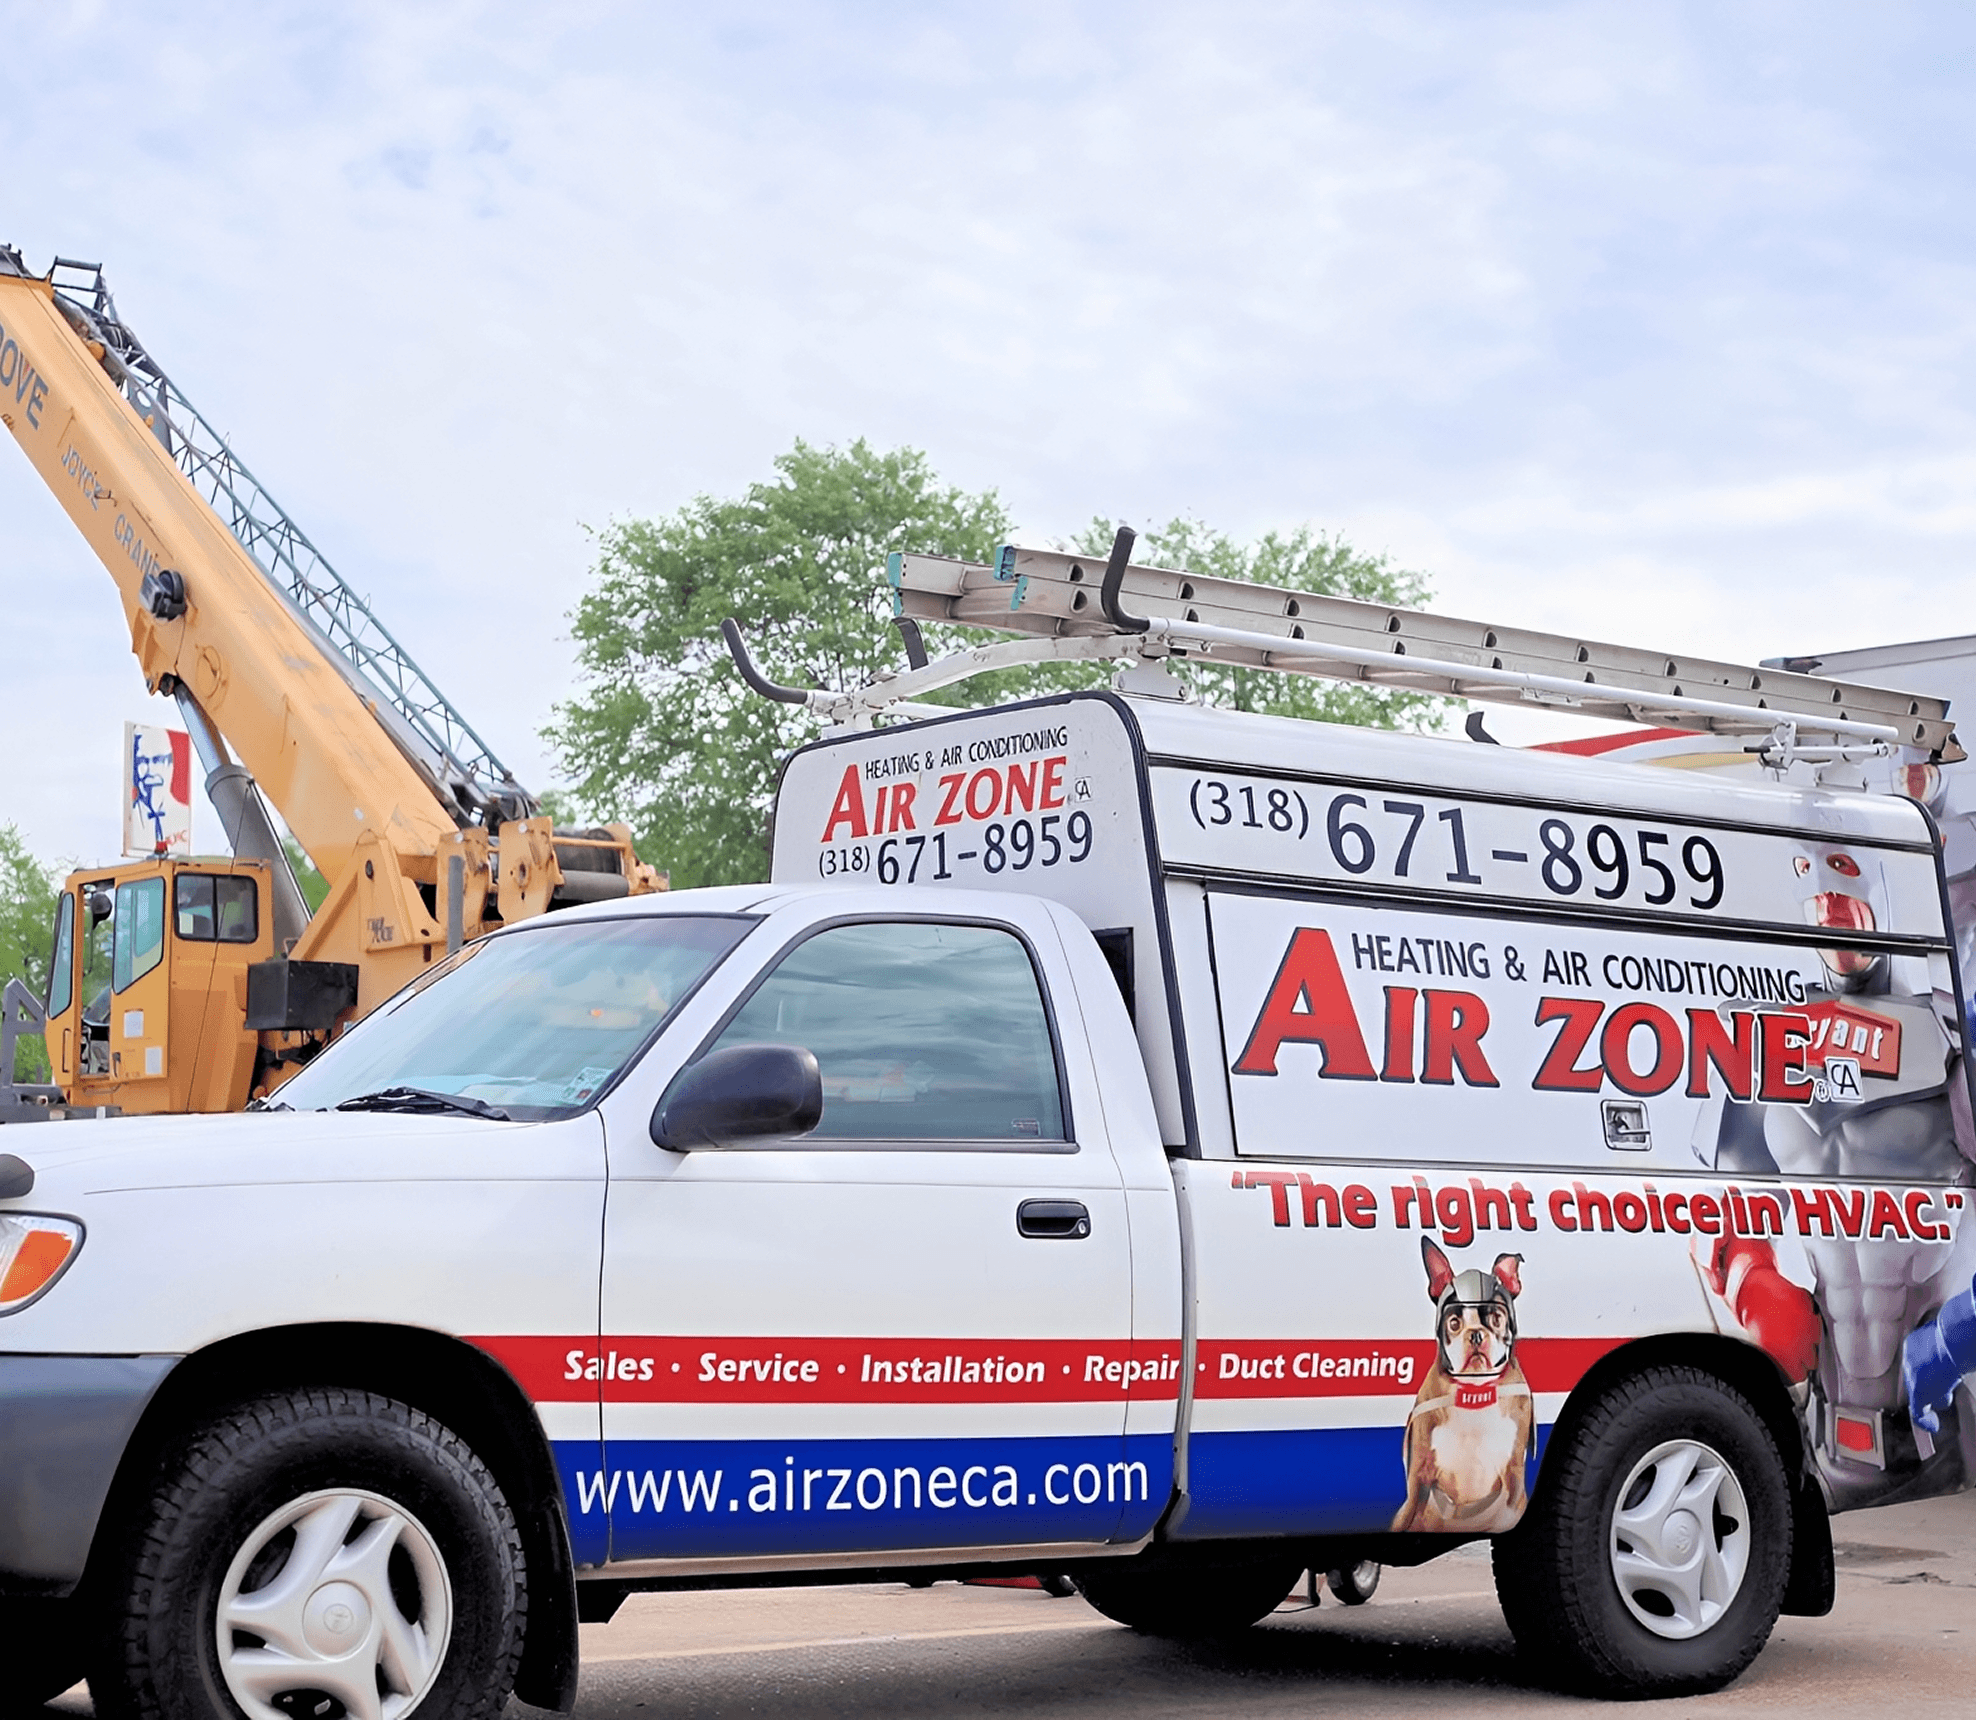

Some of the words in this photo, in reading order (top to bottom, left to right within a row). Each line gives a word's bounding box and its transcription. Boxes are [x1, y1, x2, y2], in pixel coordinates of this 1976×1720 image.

[0, 323, 48, 431] OVE
[866, 753, 919, 780] HEATING
[925, 751, 934, 770] &
[941, 746, 962, 767] AIR
[969, 726, 1067, 762] CONDITIONING
[821, 764, 917, 843] AIR
[933, 756, 1067, 826] ZONE
[819, 845, 870, 879] (318)
[877, 810, 1093, 885] 671-8959
[1190, 779, 1309, 839] (318)
[1327, 793, 1724, 910] 671-8959
[1351, 933, 1491, 978] HEATING
[1504, 945, 1527, 982] &
[1543, 949, 1591, 987] AIR
[1603, 955, 1805, 1002] CONDITIONING
[1231, 926, 1500, 1088] AIR
[1532, 997, 1815, 1104] ZONE
[1231, 1171, 1377, 1228] "The
[1391, 1175, 1537, 1248] right
[1548, 1181, 1722, 1234] choice
[1727, 1185, 1784, 1236] in
[1789, 1188, 1965, 1240] HVAC."
[564, 1350, 654, 1381] Sales
[698, 1353, 820, 1383] Service
[861, 1354, 1045, 1383] Installation
[1083, 1354, 1180, 1390] Repair
[1219, 1353, 1285, 1379] Duct
[1292, 1351, 1414, 1384] Cleaning
[576, 1456, 1149, 1515] www.airzoneca.com
